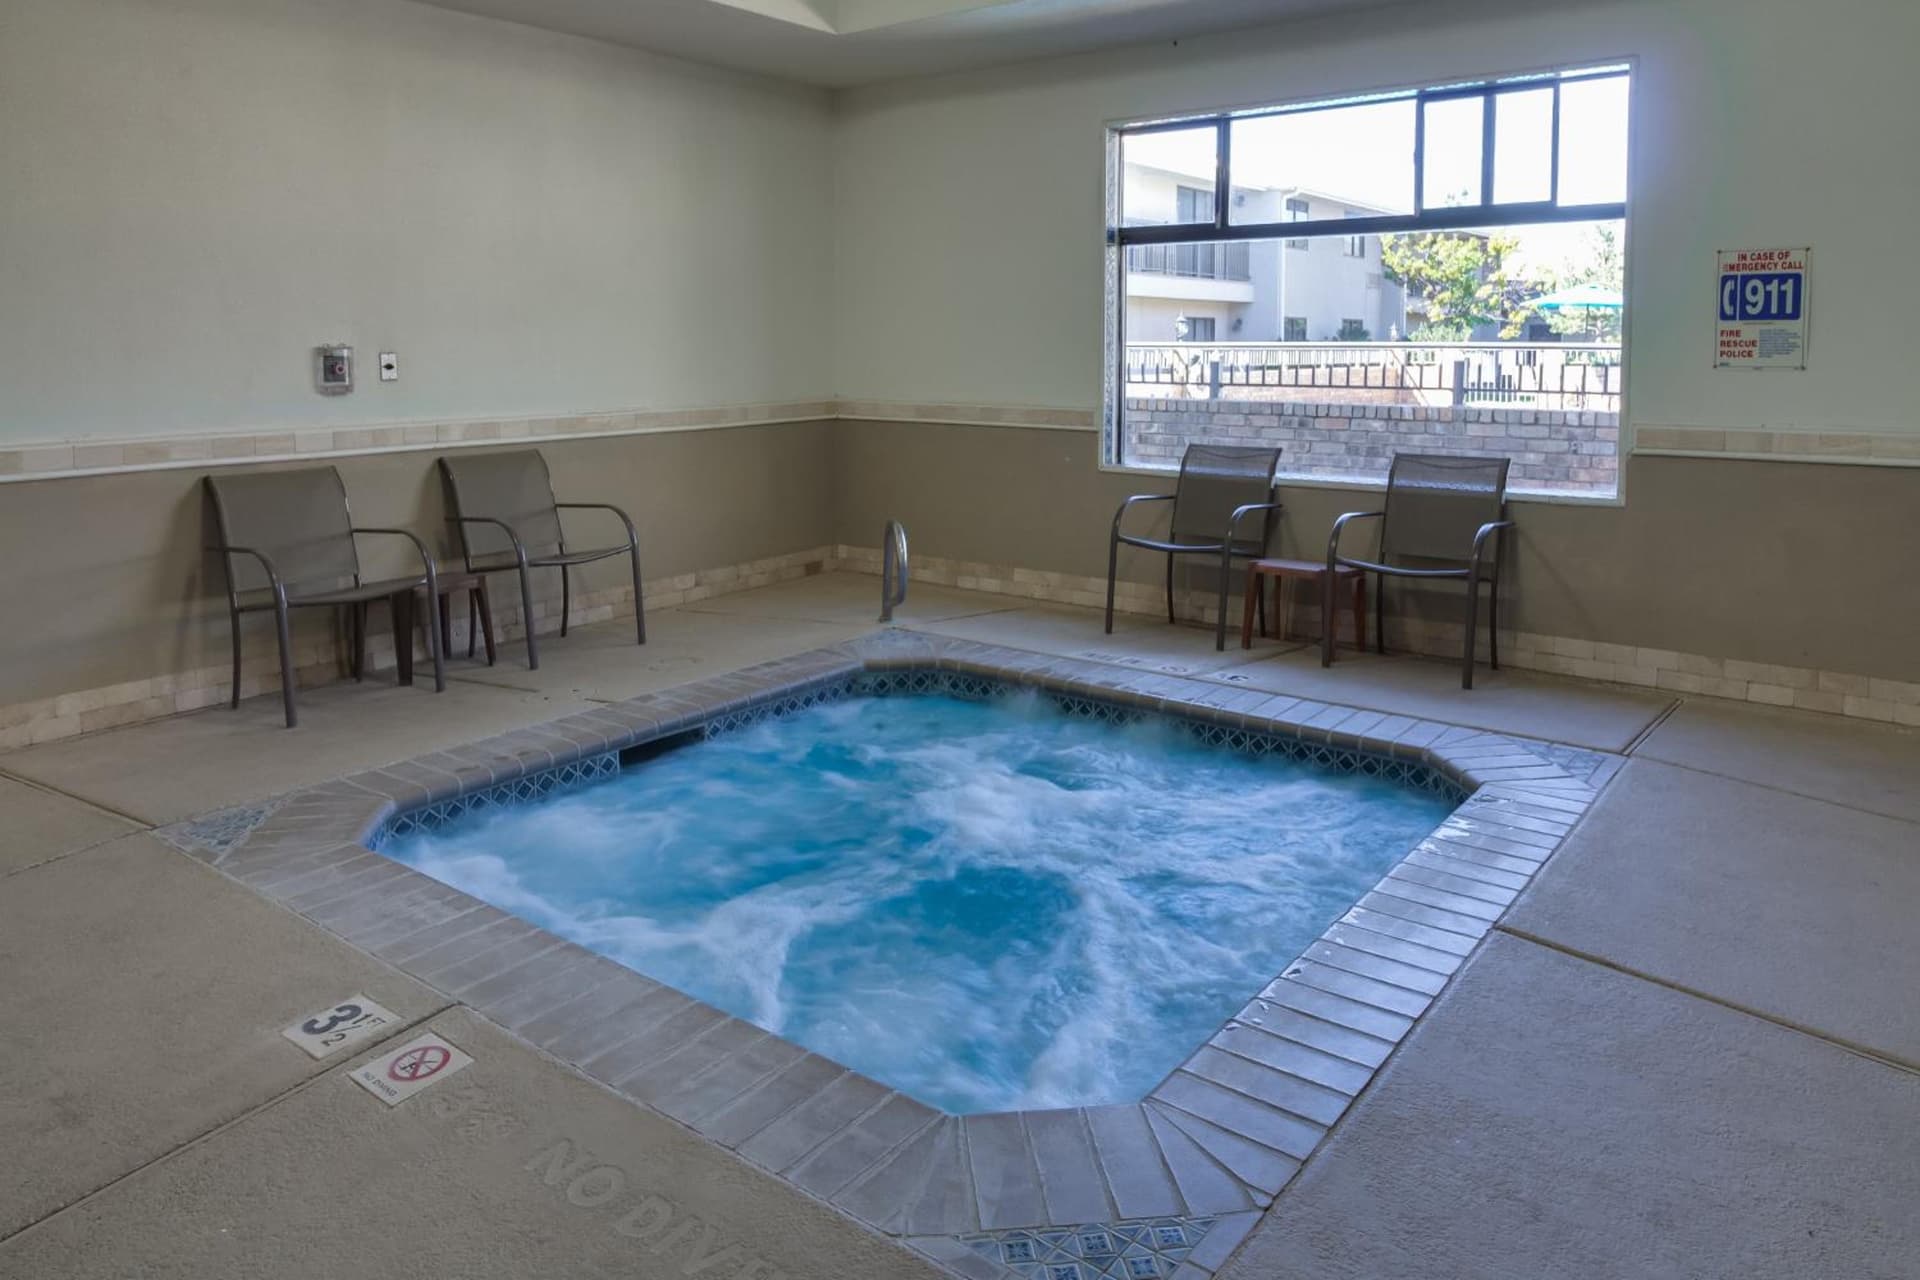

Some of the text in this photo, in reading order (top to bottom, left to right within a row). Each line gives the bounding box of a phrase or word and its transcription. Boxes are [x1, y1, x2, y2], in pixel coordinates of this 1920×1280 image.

[1737, 251, 1790, 261] IN CASE OF
[1722, 261, 1803, 272] EMERGENCY CALL
[1745, 278, 1794, 315] 911
[1720, 329, 1742, 337] FIRE
[1720, 350, 1753, 358] POLICE
[523, 1137, 627, 1208] NO
